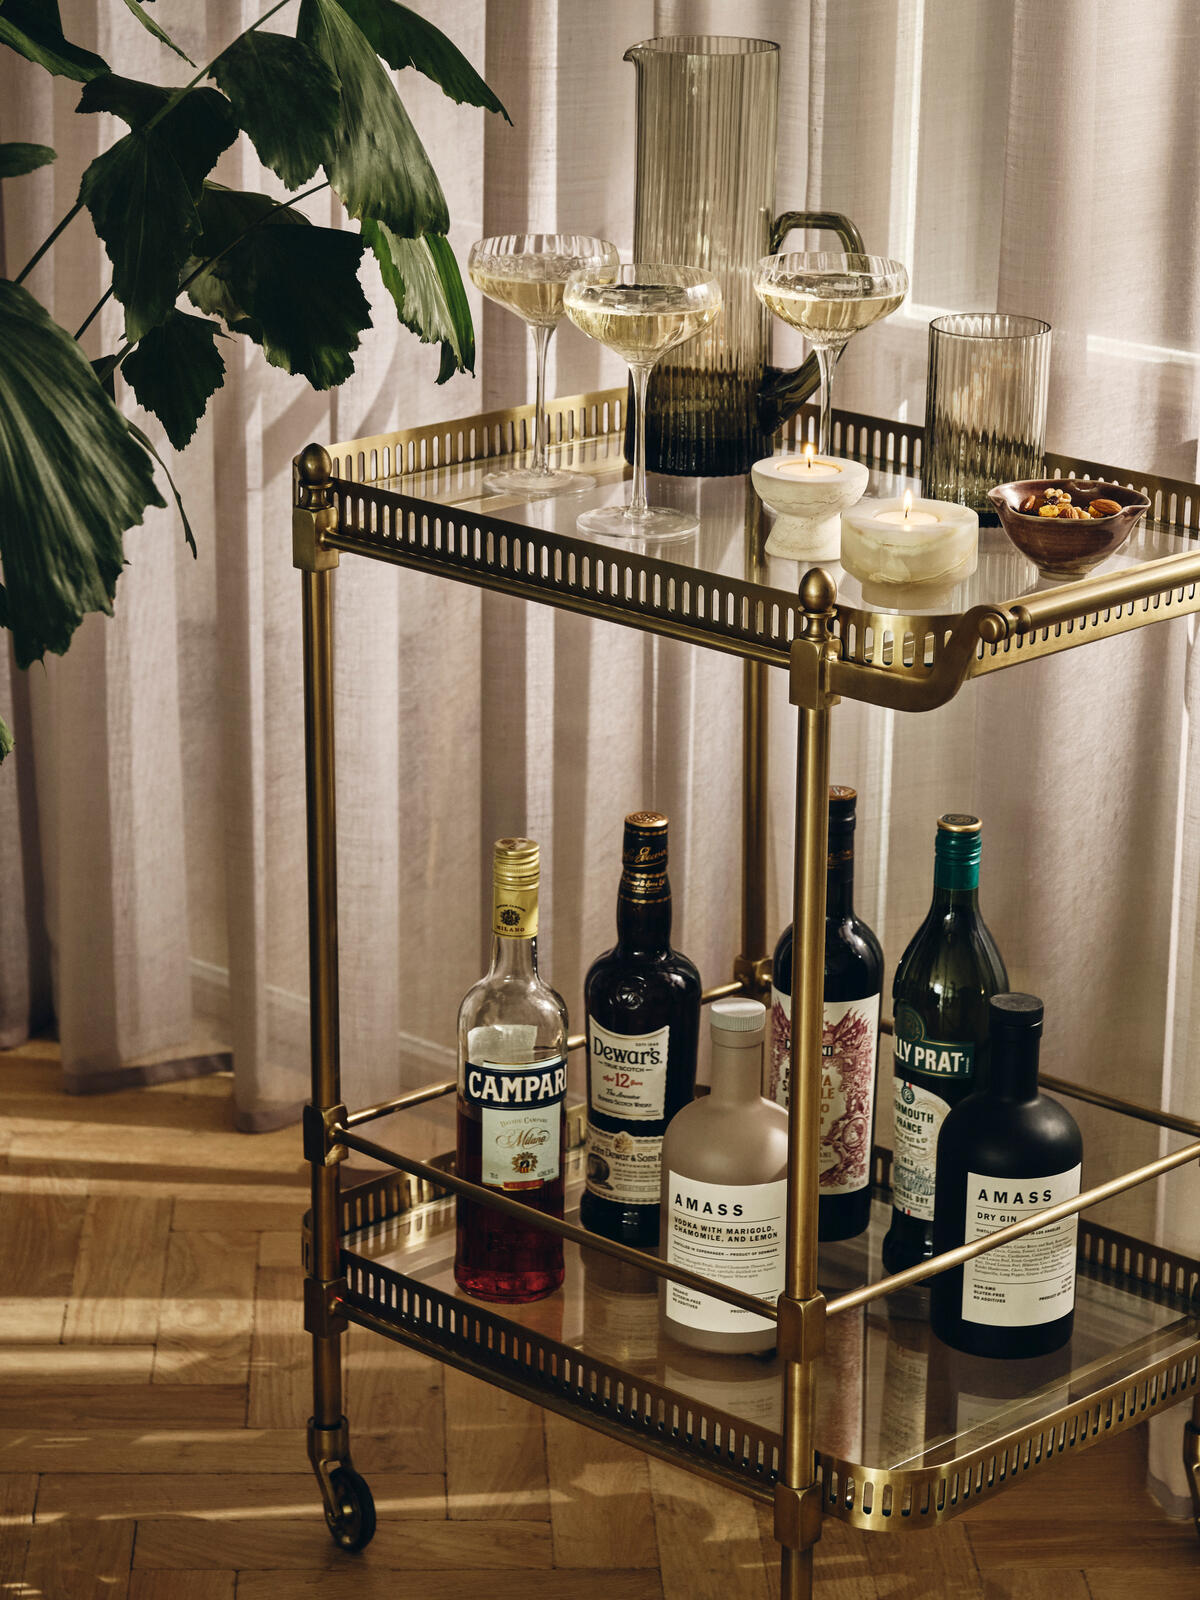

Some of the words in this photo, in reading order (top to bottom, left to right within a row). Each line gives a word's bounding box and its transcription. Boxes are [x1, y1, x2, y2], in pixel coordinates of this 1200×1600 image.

[593, 1036, 660, 1065] Dewar's
[914, 1046, 963, 1073] PRAT
[619, 1065, 645, 1073] SCOTCH
[468, 1063, 567, 1103] CAMPARI
[615, 1072, 630, 1088] 12
[675, 1193, 743, 1216] AMASS
[978, 1189, 1052, 1205] AMASS
[674, 1216, 698, 1230] VODKA
[700, 1225, 722, 1234] WITH
[977, 1211, 996, 1221] DRY
[1000, 1215, 1017, 1223] GIN
[674, 1224, 724, 1242] CHAMOMILE,
[728, 1235, 746, 1243] AND
[750, 1231, 778, 1242] LEMON
[973, 1289, 1005, 1298] GLUTEN-FREE
